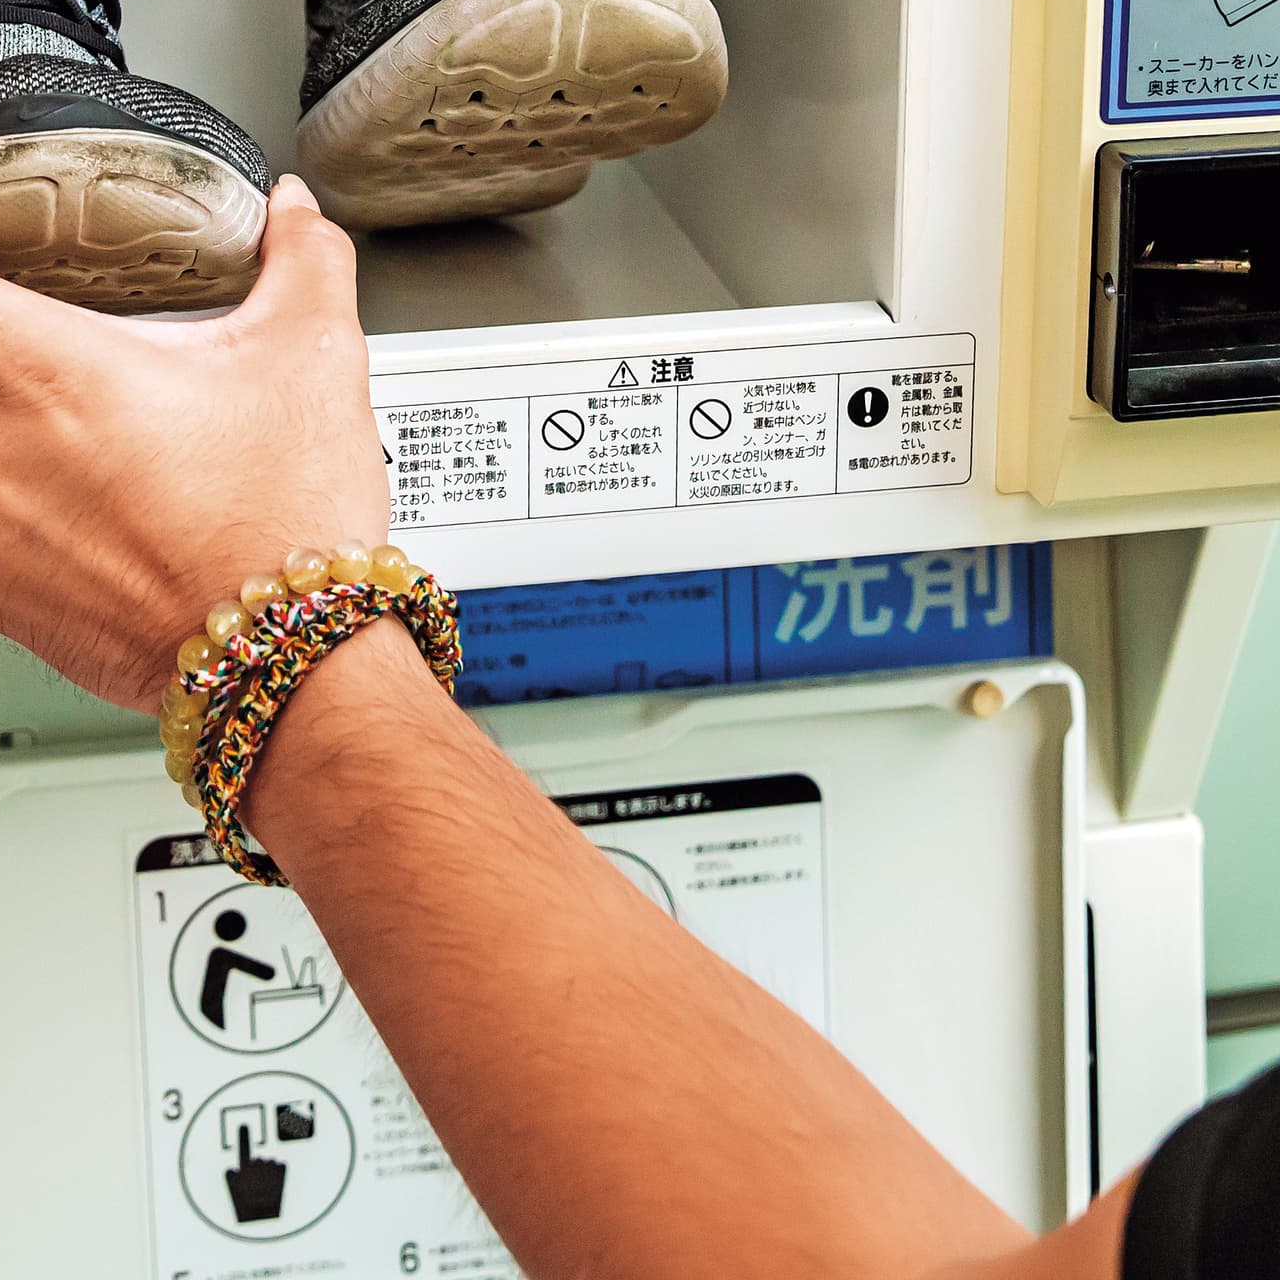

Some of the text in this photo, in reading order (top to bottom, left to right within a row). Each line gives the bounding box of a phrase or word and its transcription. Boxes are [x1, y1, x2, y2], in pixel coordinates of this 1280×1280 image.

[651, 357, 694, 383] 注意
[743, 381, 816, 398] 火気や引火物を
[588, 393, 663, 409] 靴は十分に脱水
[743, 400, 800, 414] 近づけない。
[901, 402, 963, 418] 片は靴から取
[588, 413, 614, 426] する。
[753, 412, 827, 429] 運転中はベンジ
[901, 418, 962, 434] り除いてくだ
[599, 426, 662, 441] しずくのたれ
[398, 438, 512, 456] を取り出してください。
[588, 442, 662, 459] るような靴を入
[901, 438, 925, 450] さい。
[848, 451, 956, 470] 感電の恐れがあります。
[544, 461, 635, 479] れないでください。
[689, 467, 767, 482] ないでください。
[544, 475, 656, 495] 感電の恐れがあります。
[689, 480, 798, 499] 火災の原因になります。
[775, 543, 1012, 643] 洗剤
[155, 891, 167, 922] 1
[163, 1089, 184, 1122] 3
[400, 1242, 421, 1274] 6
